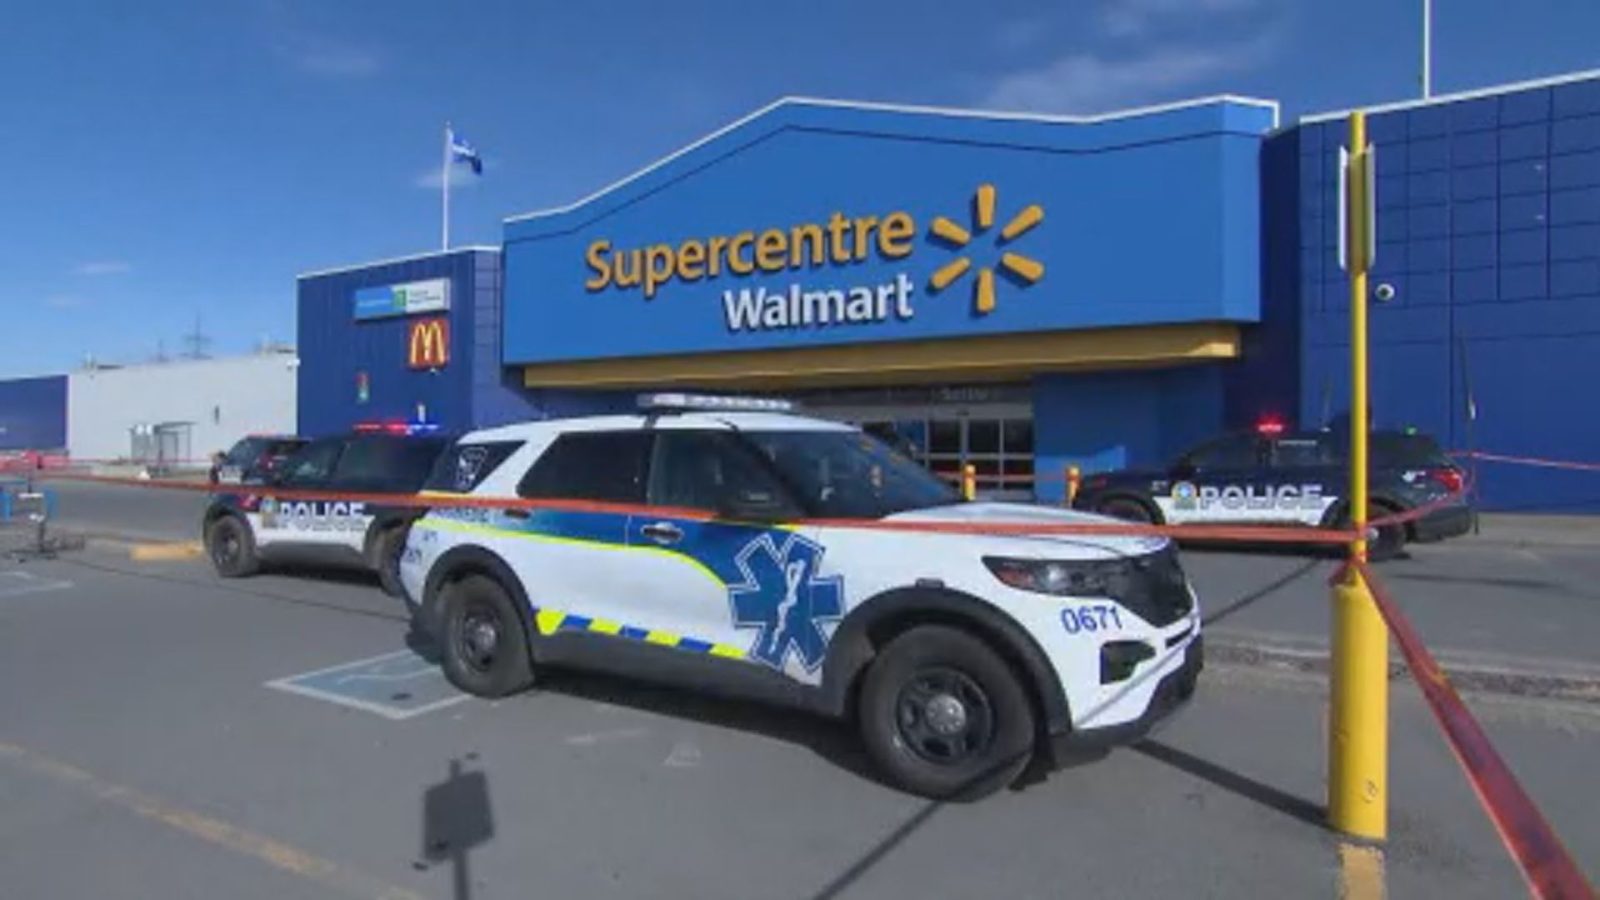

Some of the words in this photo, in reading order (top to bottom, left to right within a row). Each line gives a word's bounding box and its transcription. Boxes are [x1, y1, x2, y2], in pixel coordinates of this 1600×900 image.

[585, 209, 915, 297] Supercentre
[723, 274, 913, 331] Walmart
[1200, 483, 1324, 510] POLICE
[279, 501, 367, 532] POLICE
[1061, 605, 1122, 635] 0671
